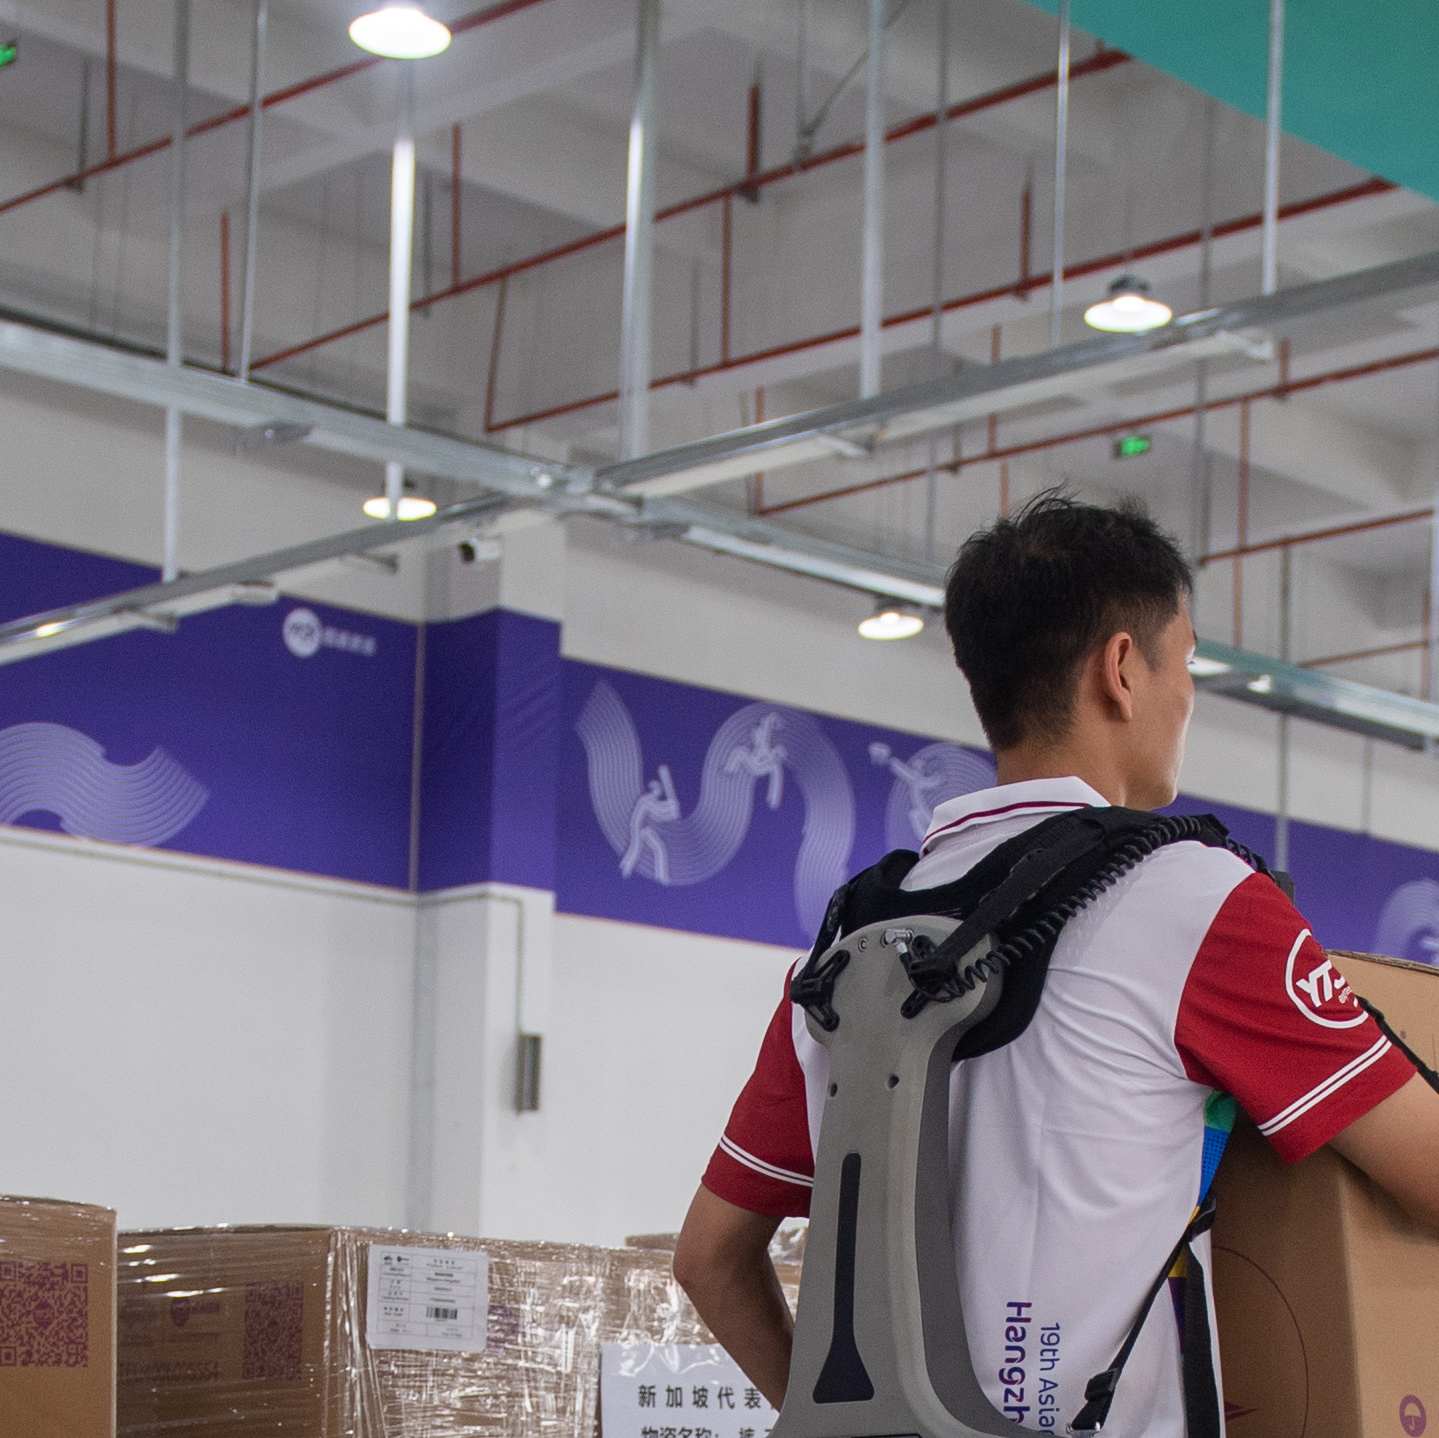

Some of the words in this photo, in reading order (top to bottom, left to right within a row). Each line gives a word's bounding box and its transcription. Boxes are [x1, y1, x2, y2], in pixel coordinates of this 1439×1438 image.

[1039, 1322, 1061, 1371] 19th
[638, 1385, 775, 1410] 新加坡代表
